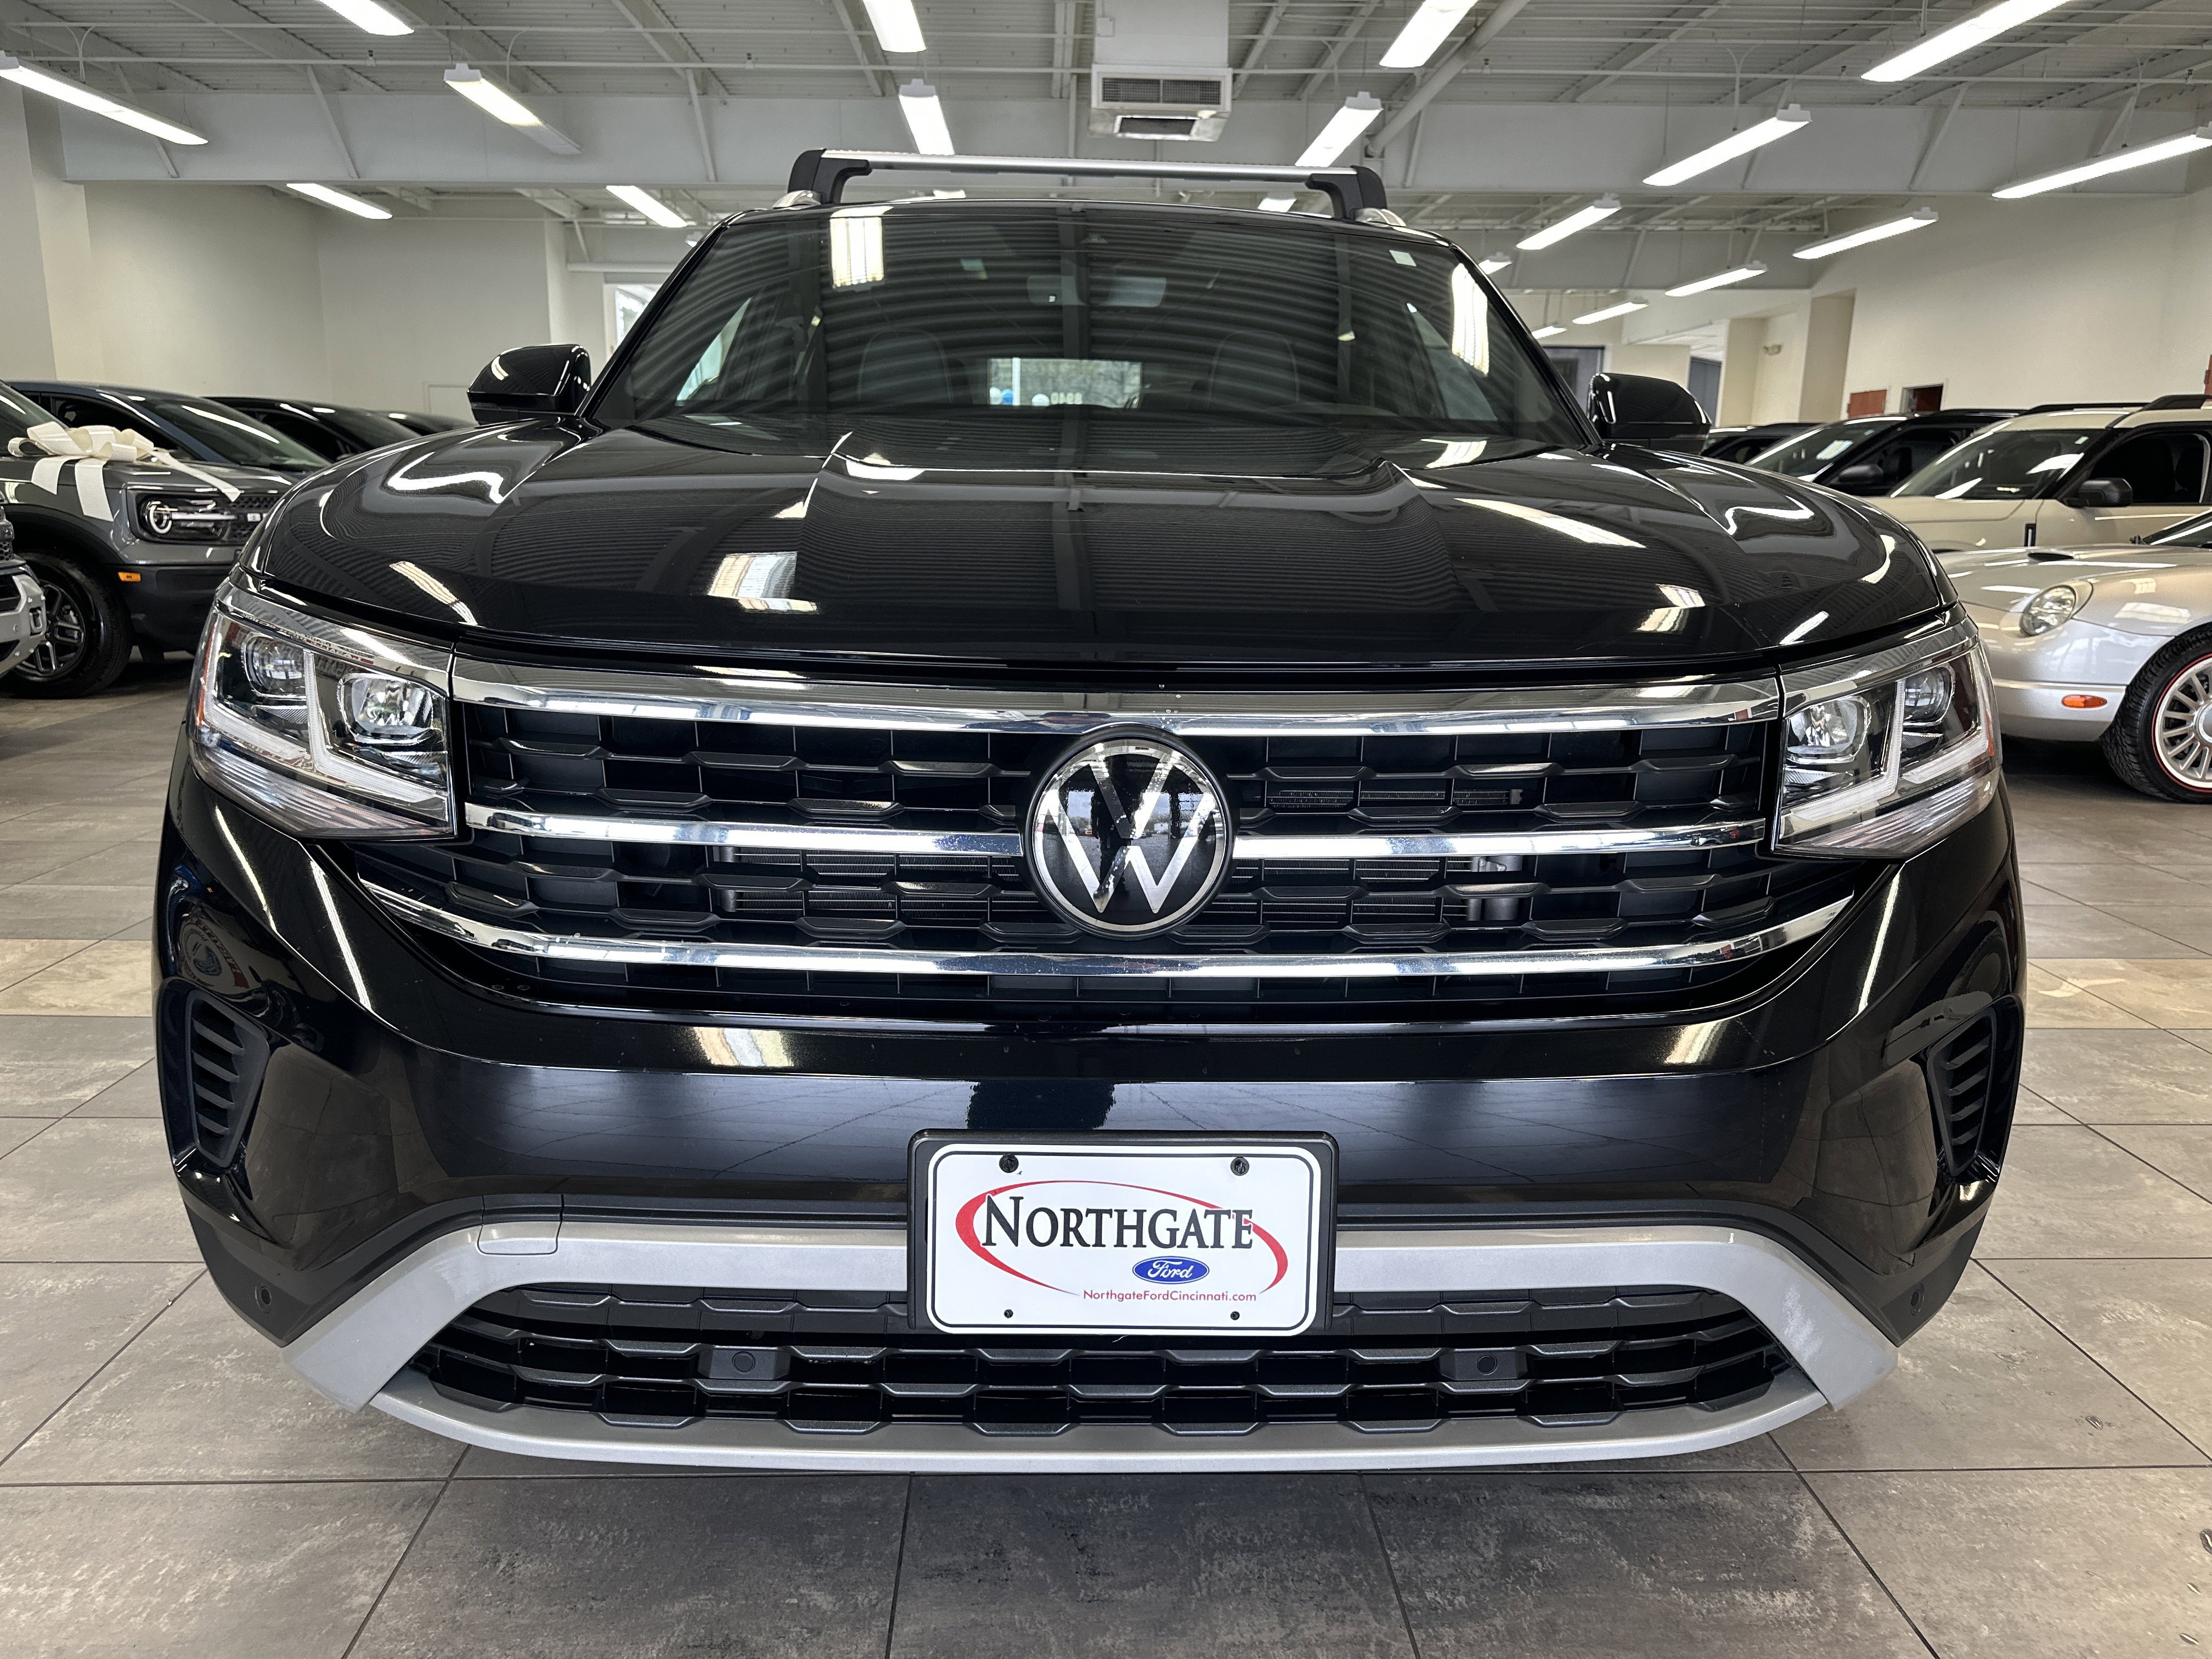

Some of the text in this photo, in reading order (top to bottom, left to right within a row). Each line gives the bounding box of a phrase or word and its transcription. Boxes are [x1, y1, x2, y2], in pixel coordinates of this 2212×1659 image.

[1036, 744, 1219, 914] VW
[981, 1195, 1252, 1249] NORTHGATE
[1148, 1260, 1194, 1279] Ford
[1083, 1289, 1257, 1302] NorthgateFordCincinnati.com
